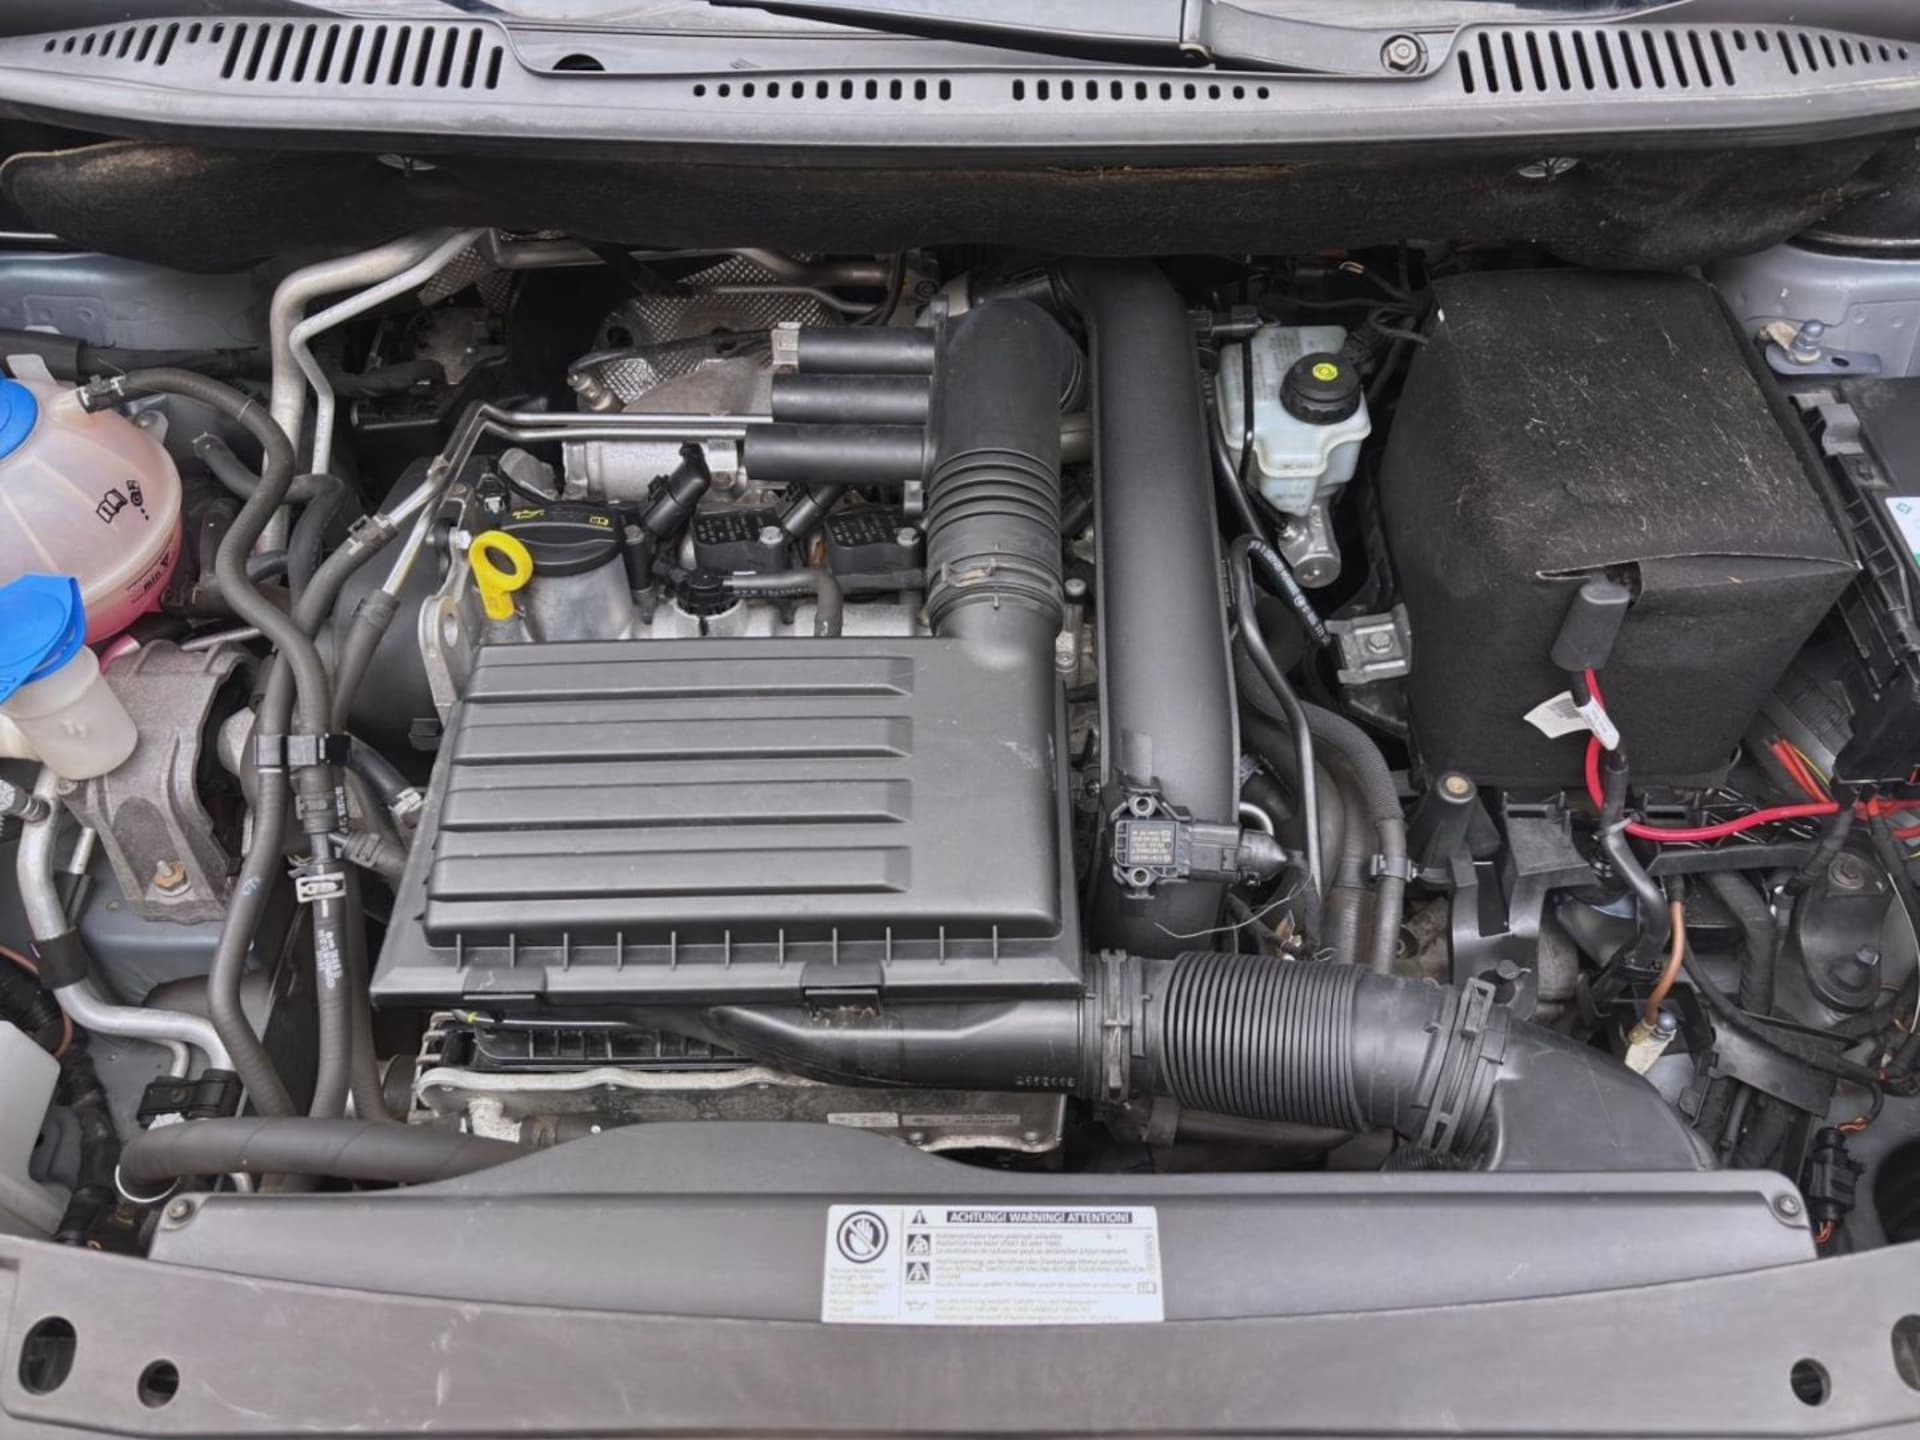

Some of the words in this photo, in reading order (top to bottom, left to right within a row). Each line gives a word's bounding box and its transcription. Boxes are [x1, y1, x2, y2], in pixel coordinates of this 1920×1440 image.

[143, 571, 161, 592] min
[950, 1211, 1006, 1224] ACHTUNG!
[1009, 1211, 1064, 1224] WARNING!
[1067, 1211, 1130, 1224] ATTENTION!
